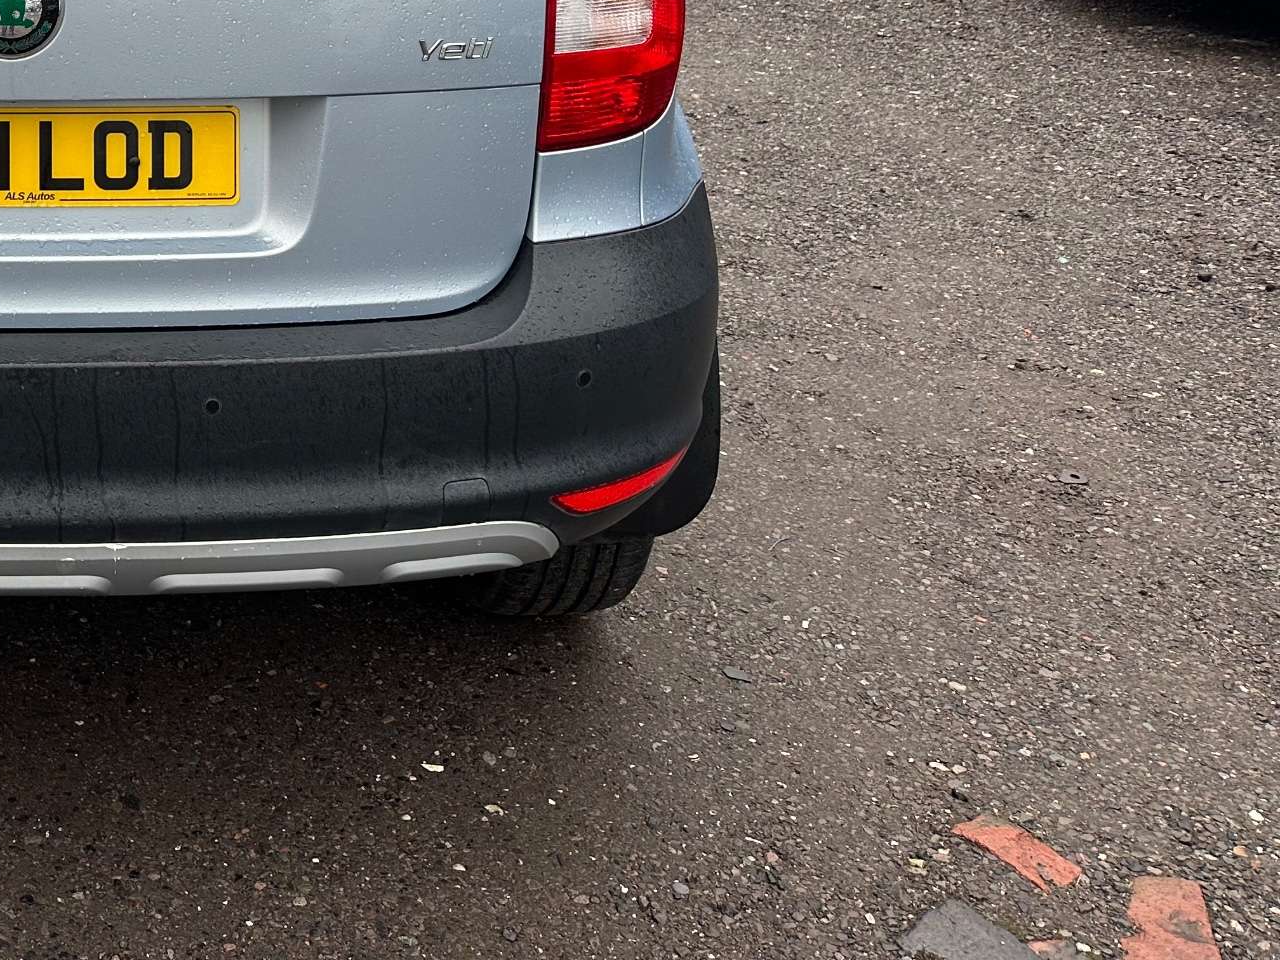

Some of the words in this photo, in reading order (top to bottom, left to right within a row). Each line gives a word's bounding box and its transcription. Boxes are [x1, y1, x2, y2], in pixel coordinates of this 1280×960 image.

[419, 36, 496, 61] Yeti
[39, 120, 193, 191] LOD
[4, 191, 26, 201] ALS
[26, 191, 56, 201] Autos
